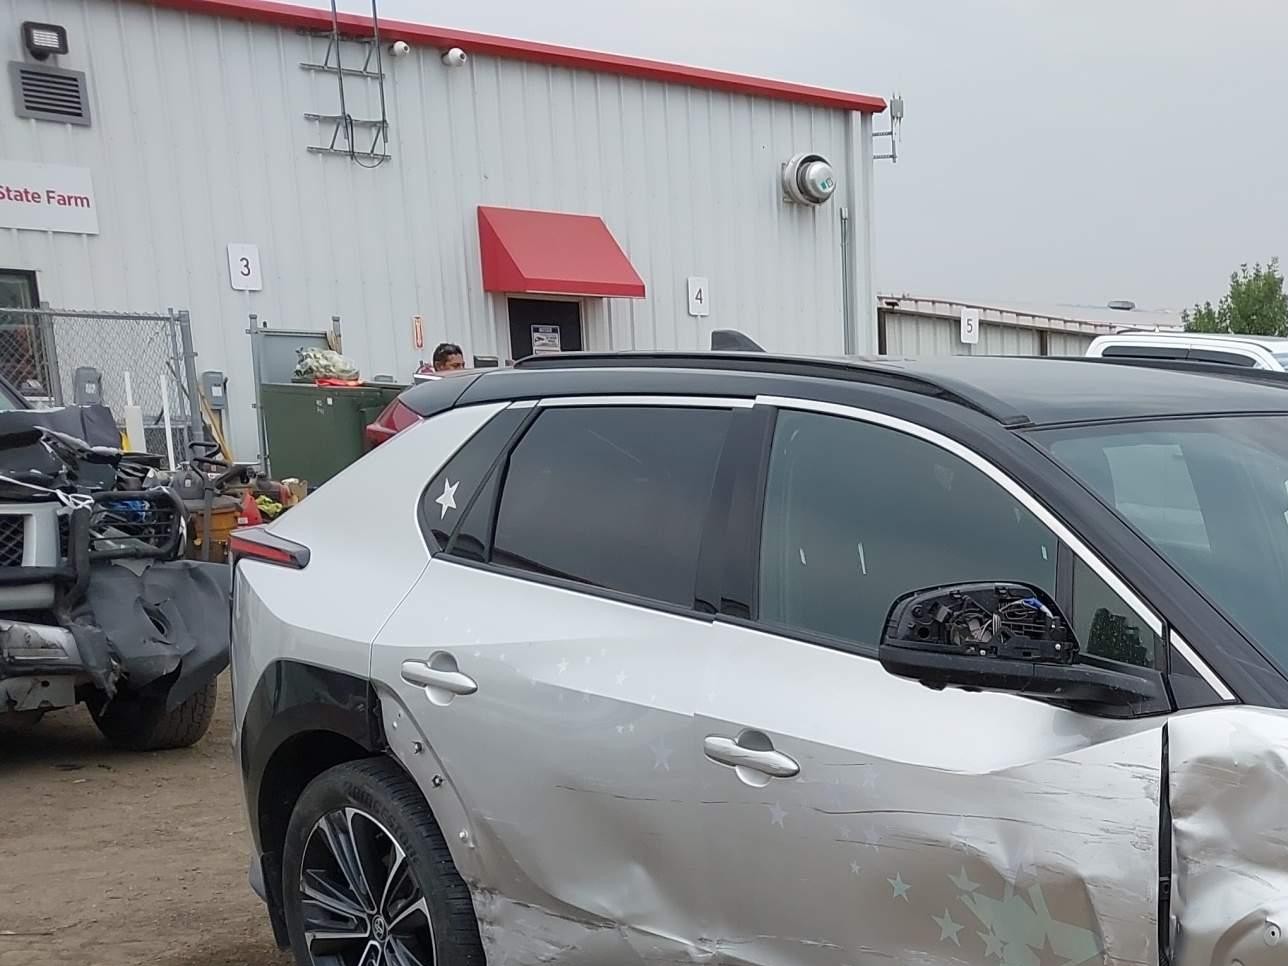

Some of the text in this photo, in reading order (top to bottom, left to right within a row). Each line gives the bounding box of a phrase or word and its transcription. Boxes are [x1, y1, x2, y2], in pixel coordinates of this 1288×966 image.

[0, 185, 91, 208] State Farm
[239, 257, 251, 277] 3
[695, 287, 703, 305] 4
[966, 318, 973, 334] 5
